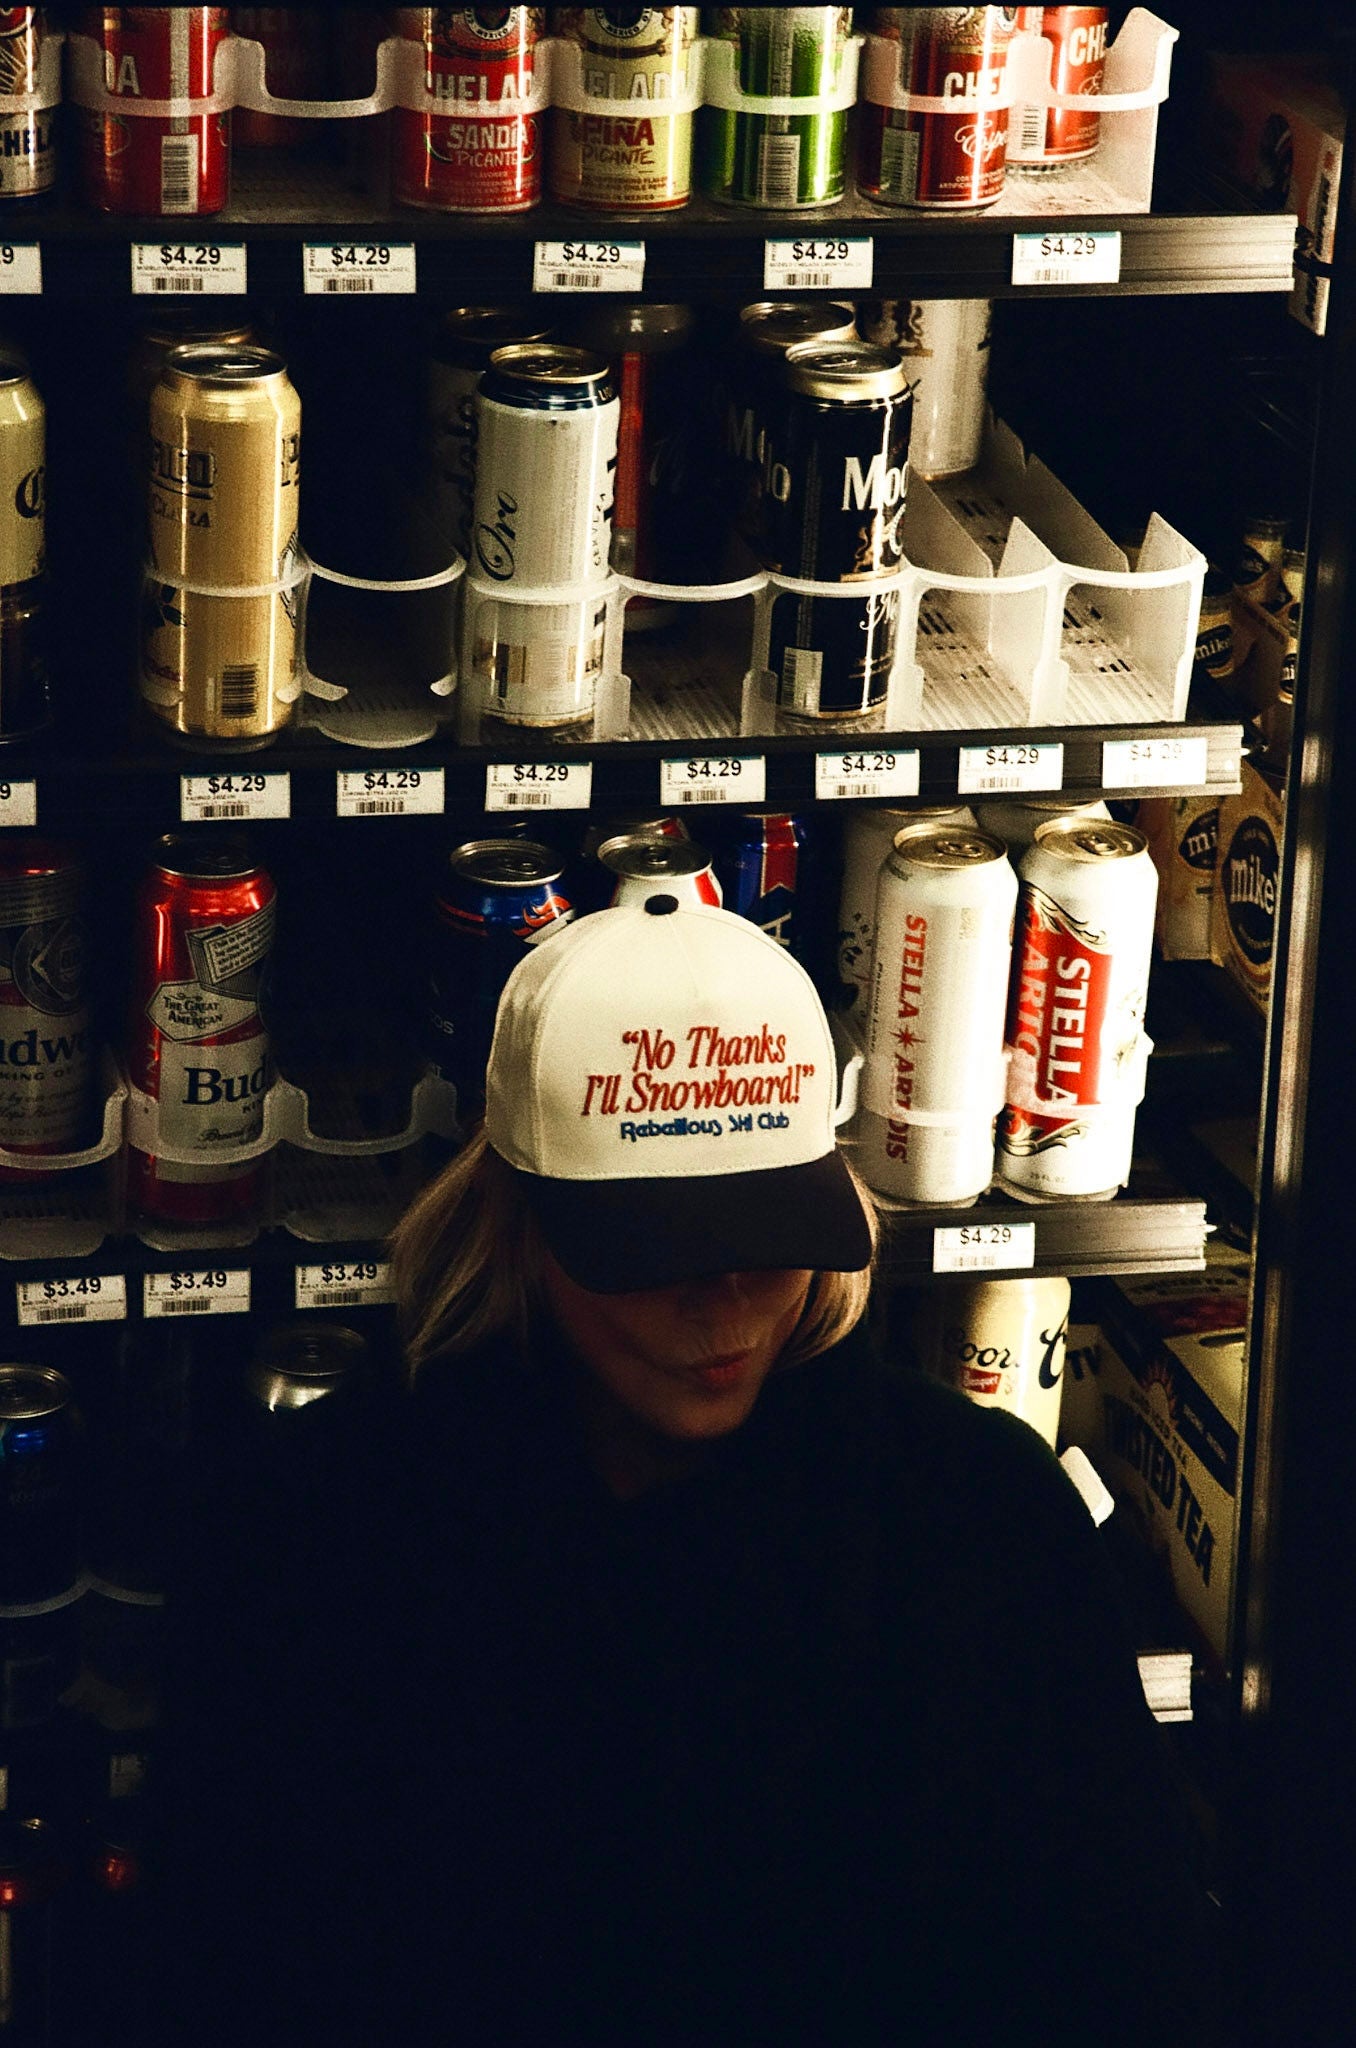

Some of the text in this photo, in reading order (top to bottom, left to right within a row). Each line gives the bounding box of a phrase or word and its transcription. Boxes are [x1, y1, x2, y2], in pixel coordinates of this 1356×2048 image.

[0, 127, 47, 157] HEL
[160, 246, 221, 266] $4.29
[331, 246, 391, 266] $4.29
[562, 242, 621, 262] $4.29
[792, 241, 849, 261] $4.29
[1041, 236, 1096, 256] $4.29
[842, 755, 896, 773] $4.29
[986, 748, 1039, 765] $4.29
[513, 764, 569, 782] $4.29
[687, 760, 742, 779] $4.29
[208, 776, 266, 794] $4.29
[364, 772, 420, 790] $4.29
[168, 1010, 224, 1026] AMERICAN
[885, 914, 928, 1164] STELLA ARTOIS
[1046, 956, 1092, 1106] STELLA
[687, 1023, 787, 1069] Thanks
[581, 1074, 622, 1117] I'll
[757, 1111, 790, 1130] Club
[960, 1227, 1012, 1245] $4.29
[170, 1271, 227, 1290] $3.49
[322, 1264, 377, 1283] $3.49
[43, 1277, 101, 1299] $3.49
[1177, 1473, 1215, 1588] TEA
